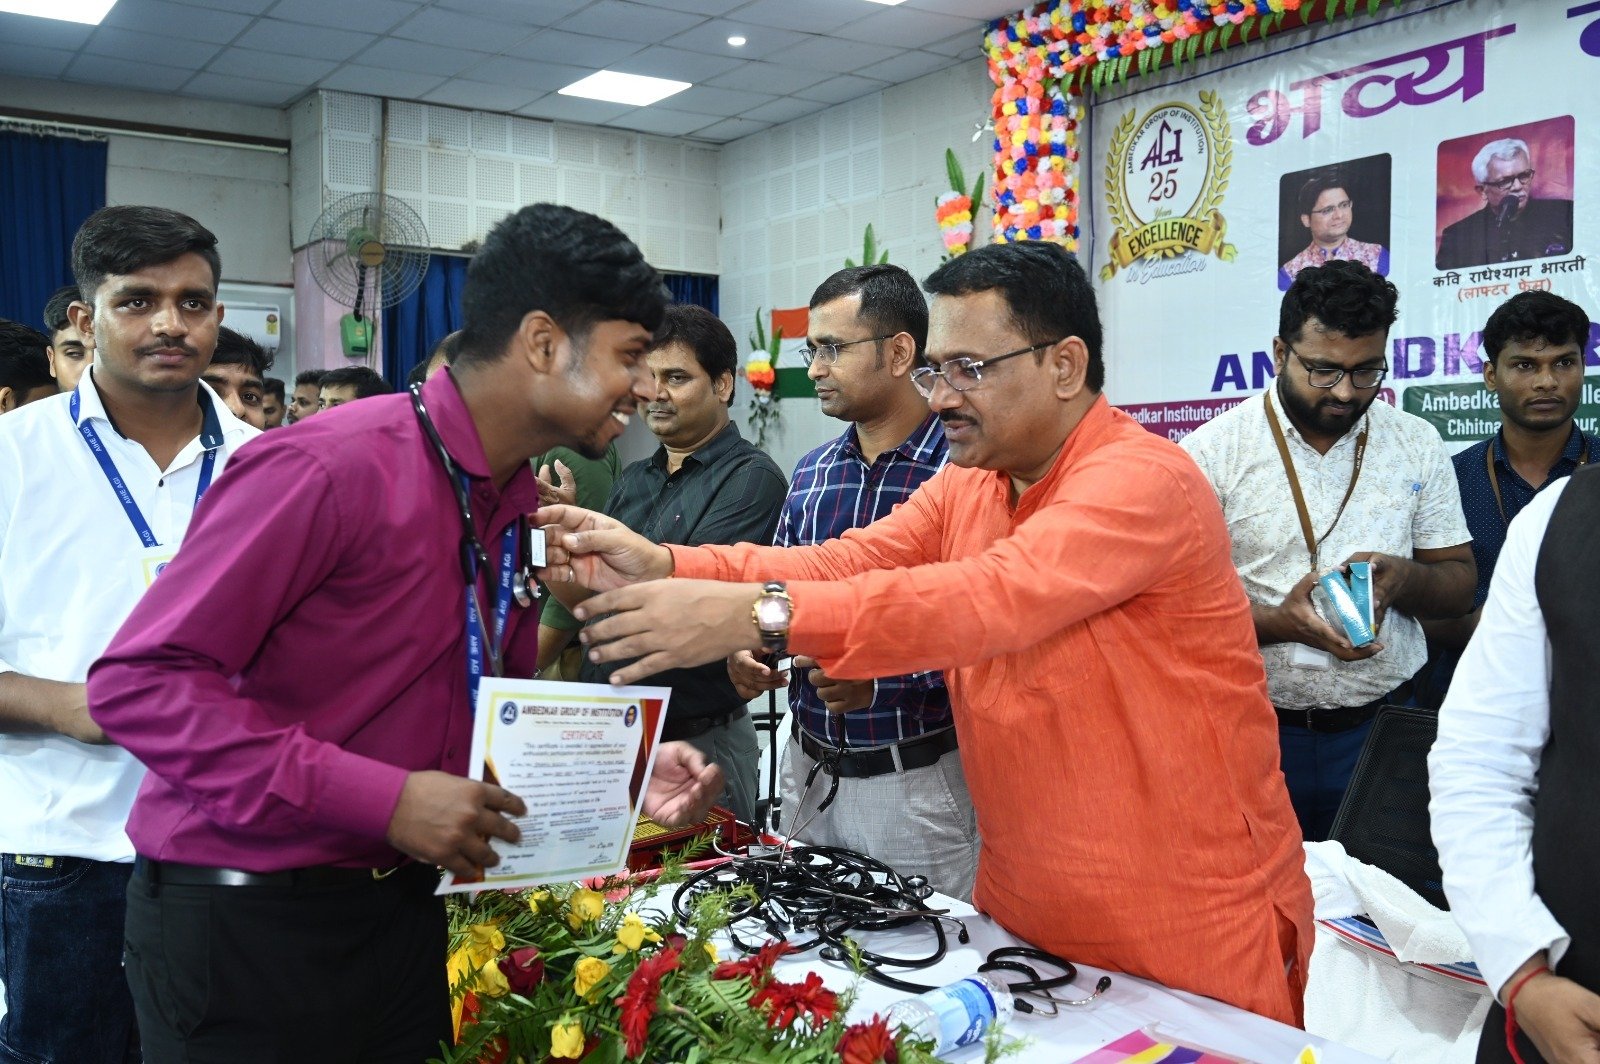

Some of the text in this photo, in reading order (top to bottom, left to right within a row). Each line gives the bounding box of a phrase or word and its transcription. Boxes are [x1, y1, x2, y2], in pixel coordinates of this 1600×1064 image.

[1246, 23, 1516, 146] भव्य
[1129, 110, 1204, 174] AMBEDKAR GROUP OF INSTITUTION
[1148, 168, 1179, 203] 25
[1128, 222, 1203, 257] EXCELLENCE
[1433, 255, 1587, 287] कवि राधेश्याम भारती
[1164, 405, 1211, 422] Institute
[82, 426, 103, 452] AIHE AGI
[113, 477, 132, 504] AIHE AGI
[141, 530, 153, 542] AGI
[502, 553, 512, 588] AIHE AGI
[498, 599, 508, 615] AGI
[470, 635, 480, 674] AIHE AGI
